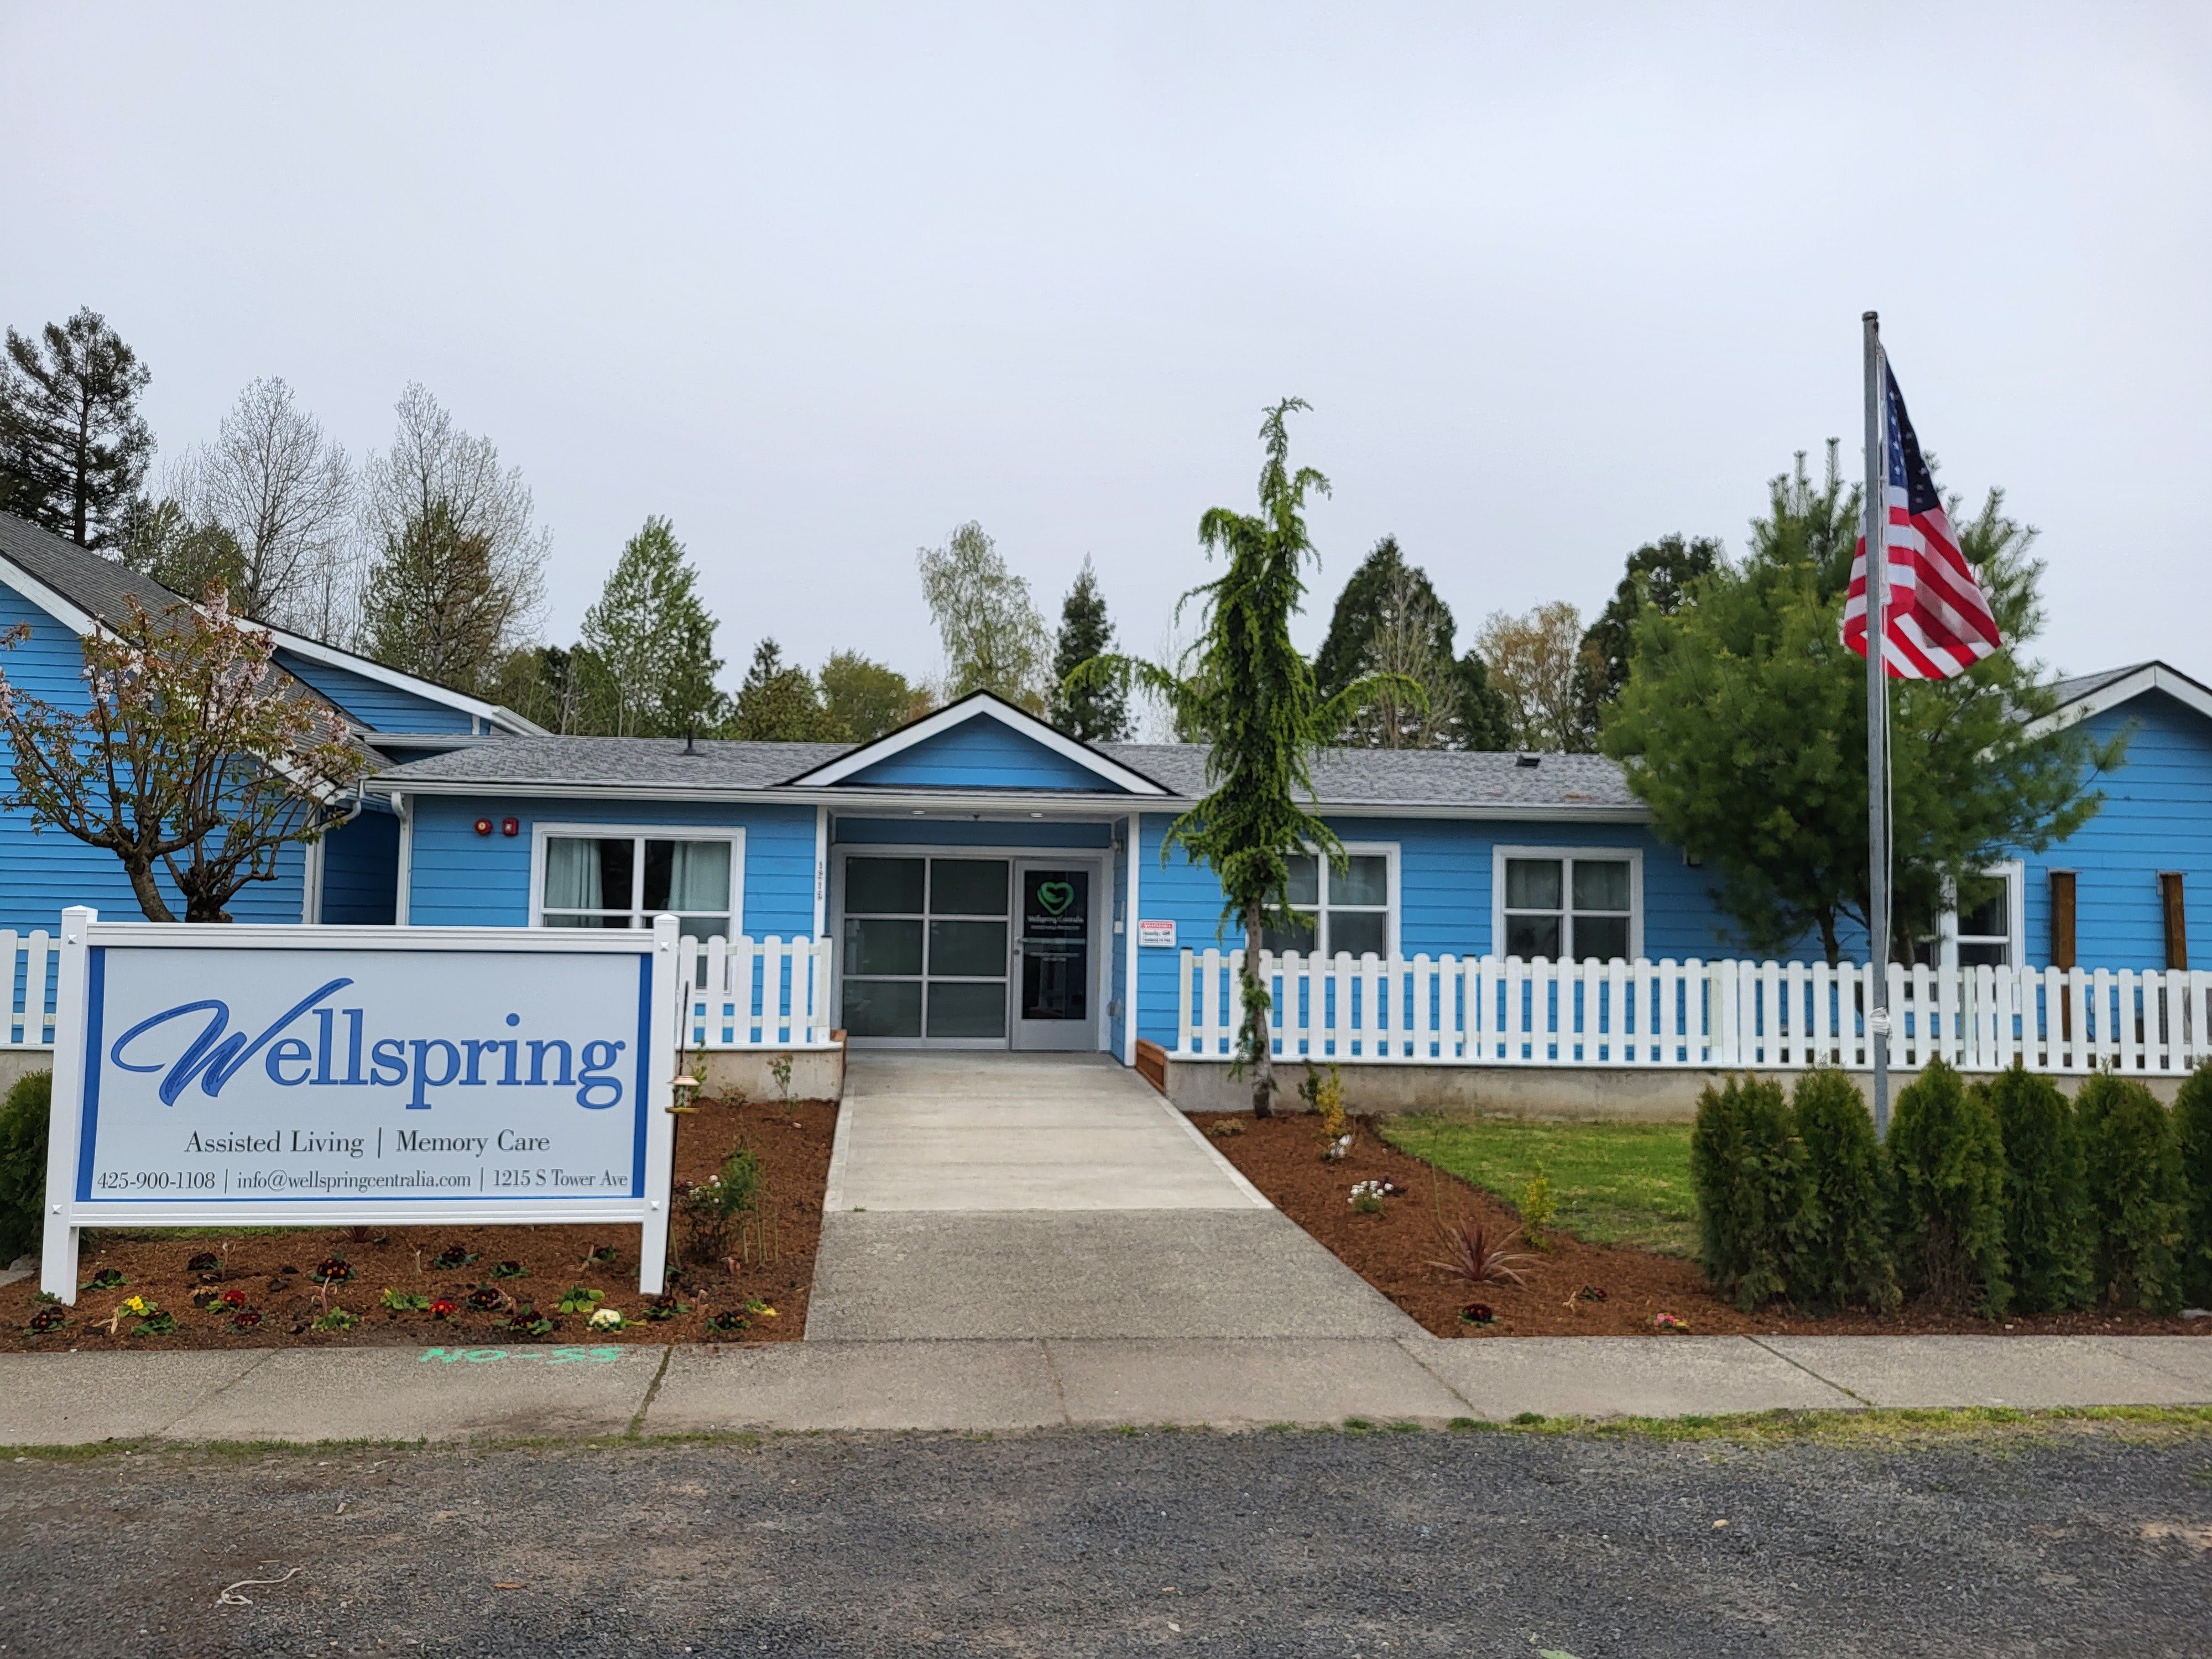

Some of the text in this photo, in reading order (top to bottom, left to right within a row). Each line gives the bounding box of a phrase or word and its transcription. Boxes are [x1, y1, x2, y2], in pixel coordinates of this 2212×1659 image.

[111, 977, 625, 1109] Wellspring
[184, 1129, 550, 1159] Assisted Living Memory Care
[97, 1168, 628, 1193] 425-900-1108 info@wellspringcentralia.com 1215 S Tower Ave
